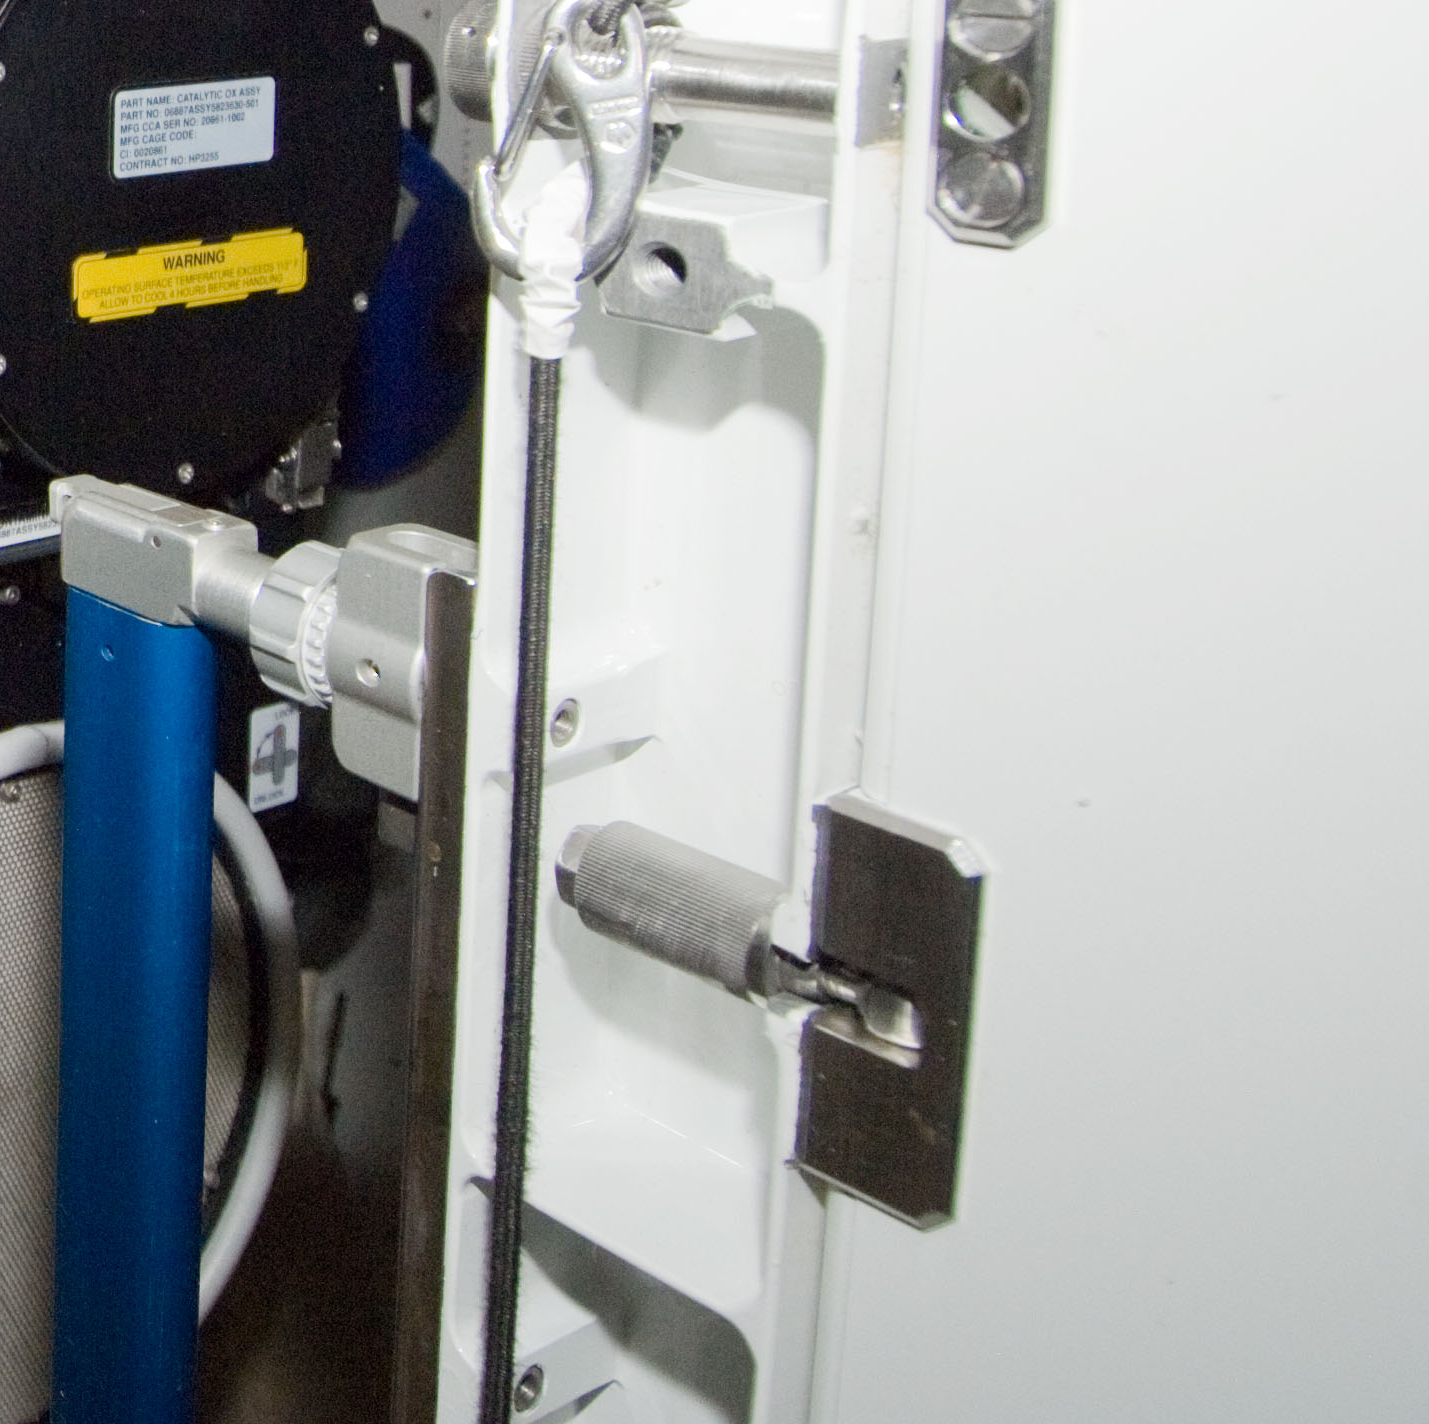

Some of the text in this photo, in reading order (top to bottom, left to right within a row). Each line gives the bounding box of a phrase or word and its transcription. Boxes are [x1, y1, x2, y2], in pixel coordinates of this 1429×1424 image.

[121, 98, 142, 109] PART
[177, 89, 223, 104] CATALYTIC
[225, 89, 237, 99] OX
[239, 86, 261, 97] ASSY
[121, 111, 142, 121] PART
[120, 124, 140, 134] MFG
[142, 121, 161, 132] CCA
[163, 119, 181, 130] SER
[120, 130, 197, 146] MFG CAGE CODE:
[120, 157, 167, 172] CONTRACT
[163, 249, 225, 270] WARNING
[82, 283, 132, 299] OPERATING
[134, 278, 173, 292] SURFACE
[175, 268, 234, 285] TEMPERATURE
[236, 262, 274, 276] EXCEEDS
[100, 296, 128, 309] ALLOW
[130, 294, 143, 305] TO
[145, 291, 168, 303] COOL
[176, 286, 207, 299] HOURS
[208, 280, 240, 295] BEFORE
[242, 274, 283, 288] HANDLING
